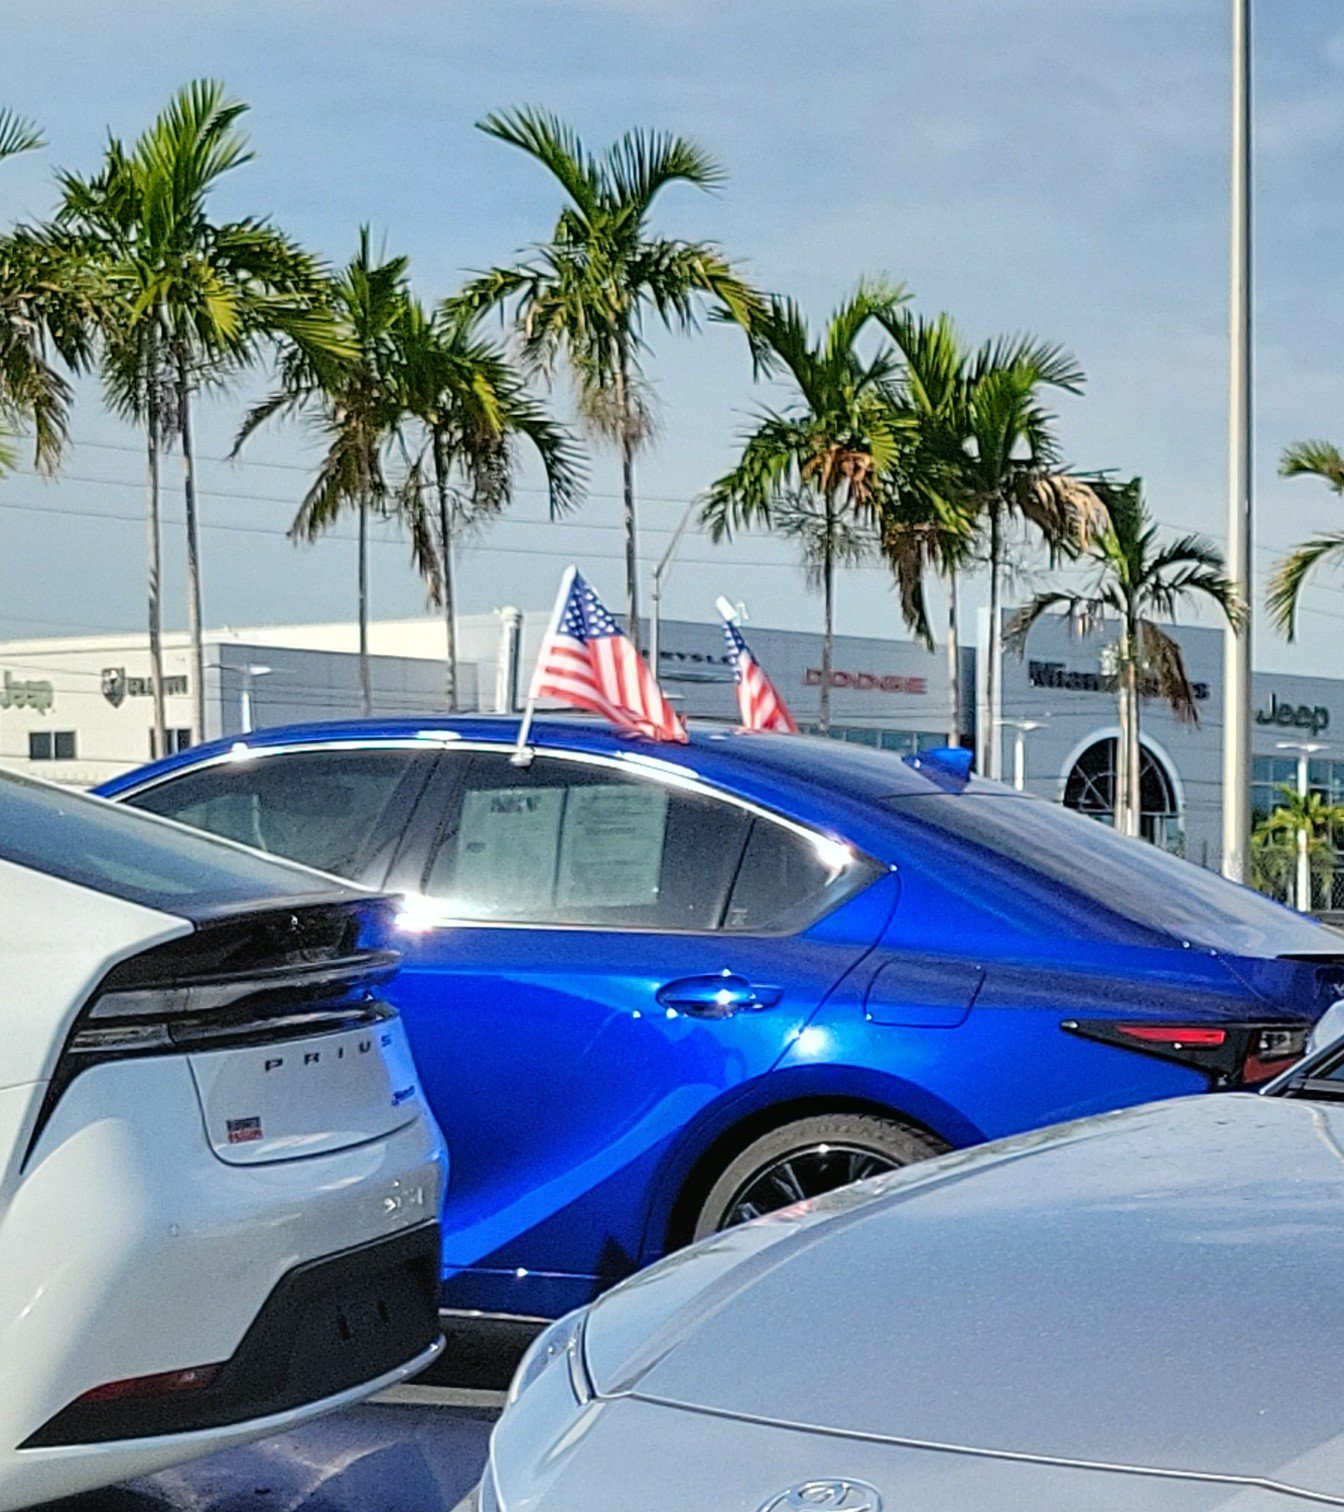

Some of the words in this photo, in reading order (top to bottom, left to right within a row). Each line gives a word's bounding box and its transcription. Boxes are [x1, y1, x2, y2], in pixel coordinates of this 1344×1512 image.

[805, 668, 928, 694] DODGE
[1256, 692, 1329, 737] Jeep
[264, 1034, 393, 1072] PRIUS
